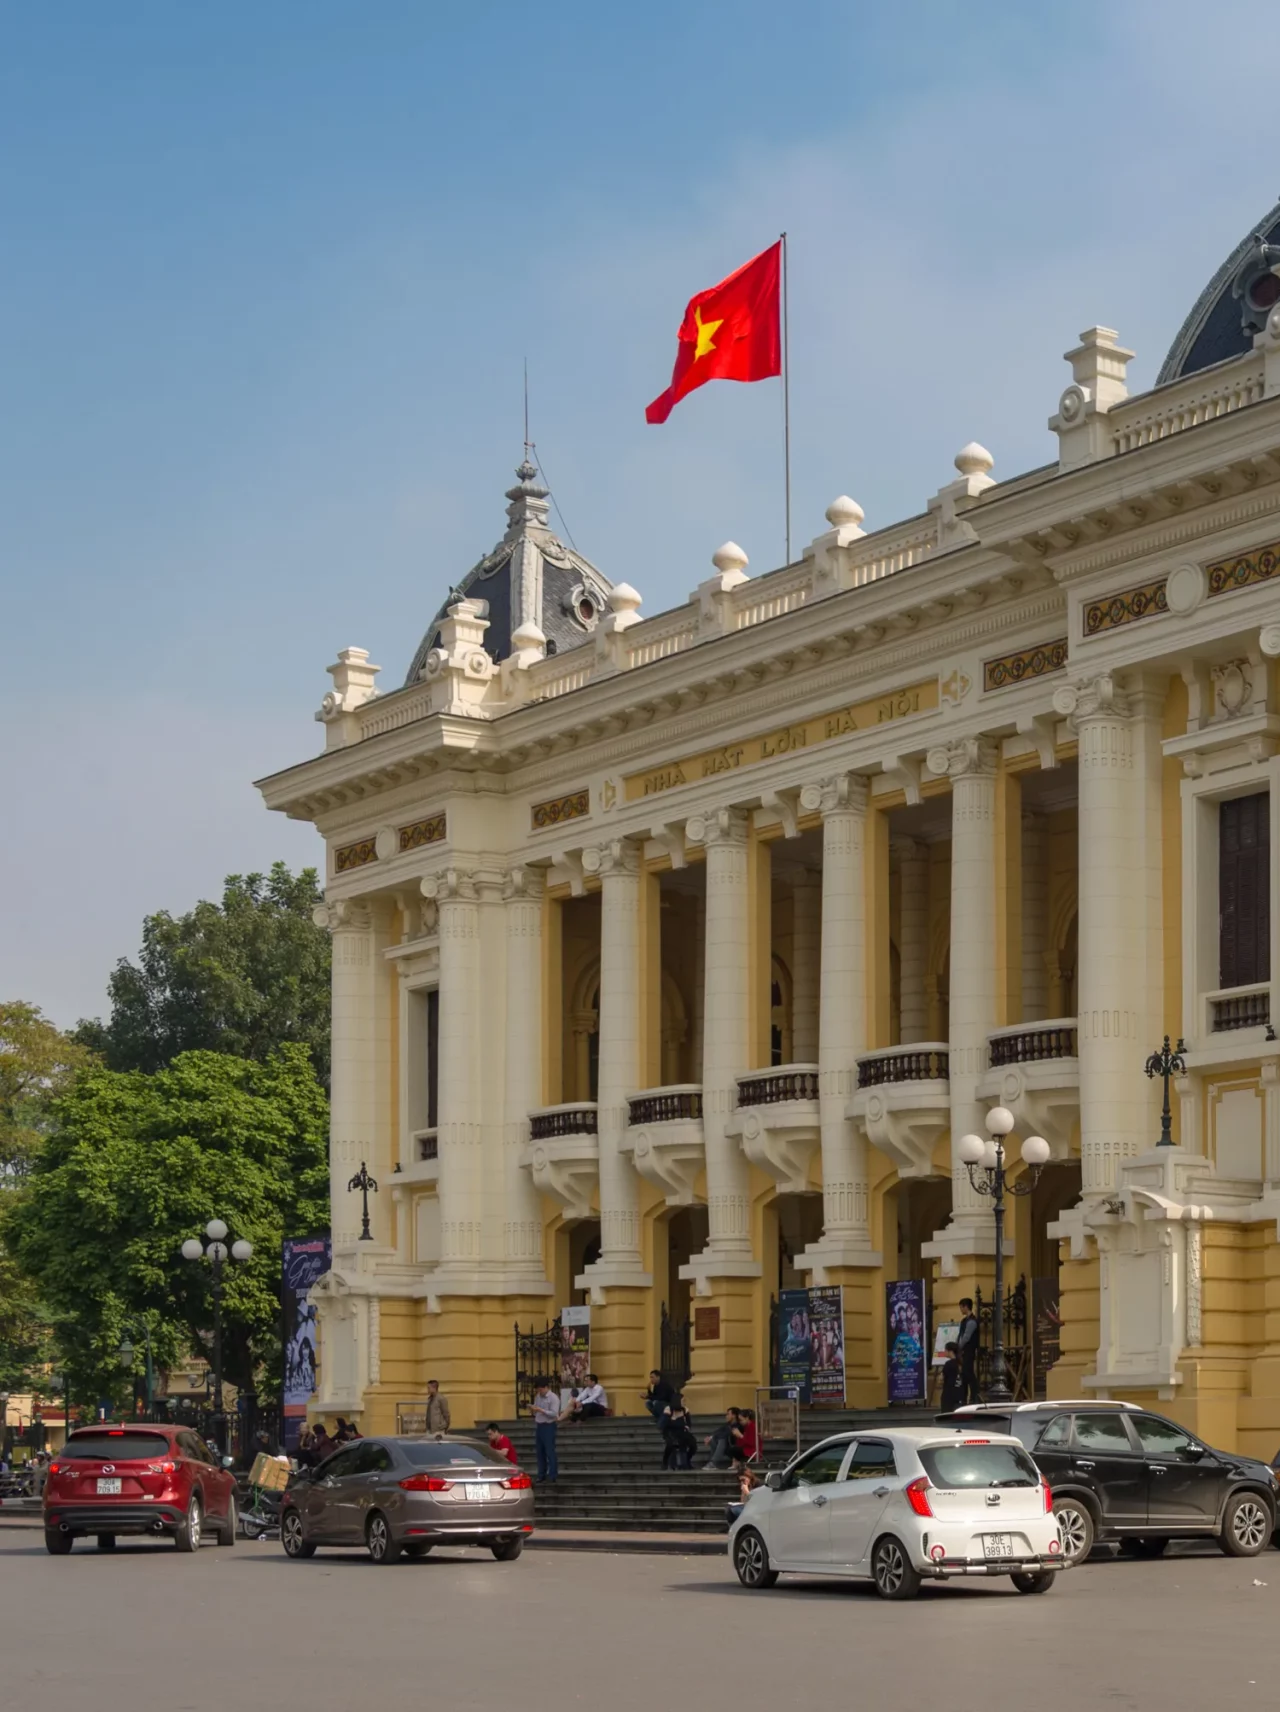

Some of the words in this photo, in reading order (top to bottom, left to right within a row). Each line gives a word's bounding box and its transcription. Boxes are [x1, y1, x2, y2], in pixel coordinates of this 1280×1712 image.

[644, 762, 687, 796] NHÀ
[702, 748, 744, 778] HÁT
[760, 727, 807, 759] LỚN
[825, 709, 858, 739] HÀ
[877, 691, 920, 723] NỘI
[990, 1535, 1005, 1545] 30E
[986, 1545, 1012, 1556] 389.13
